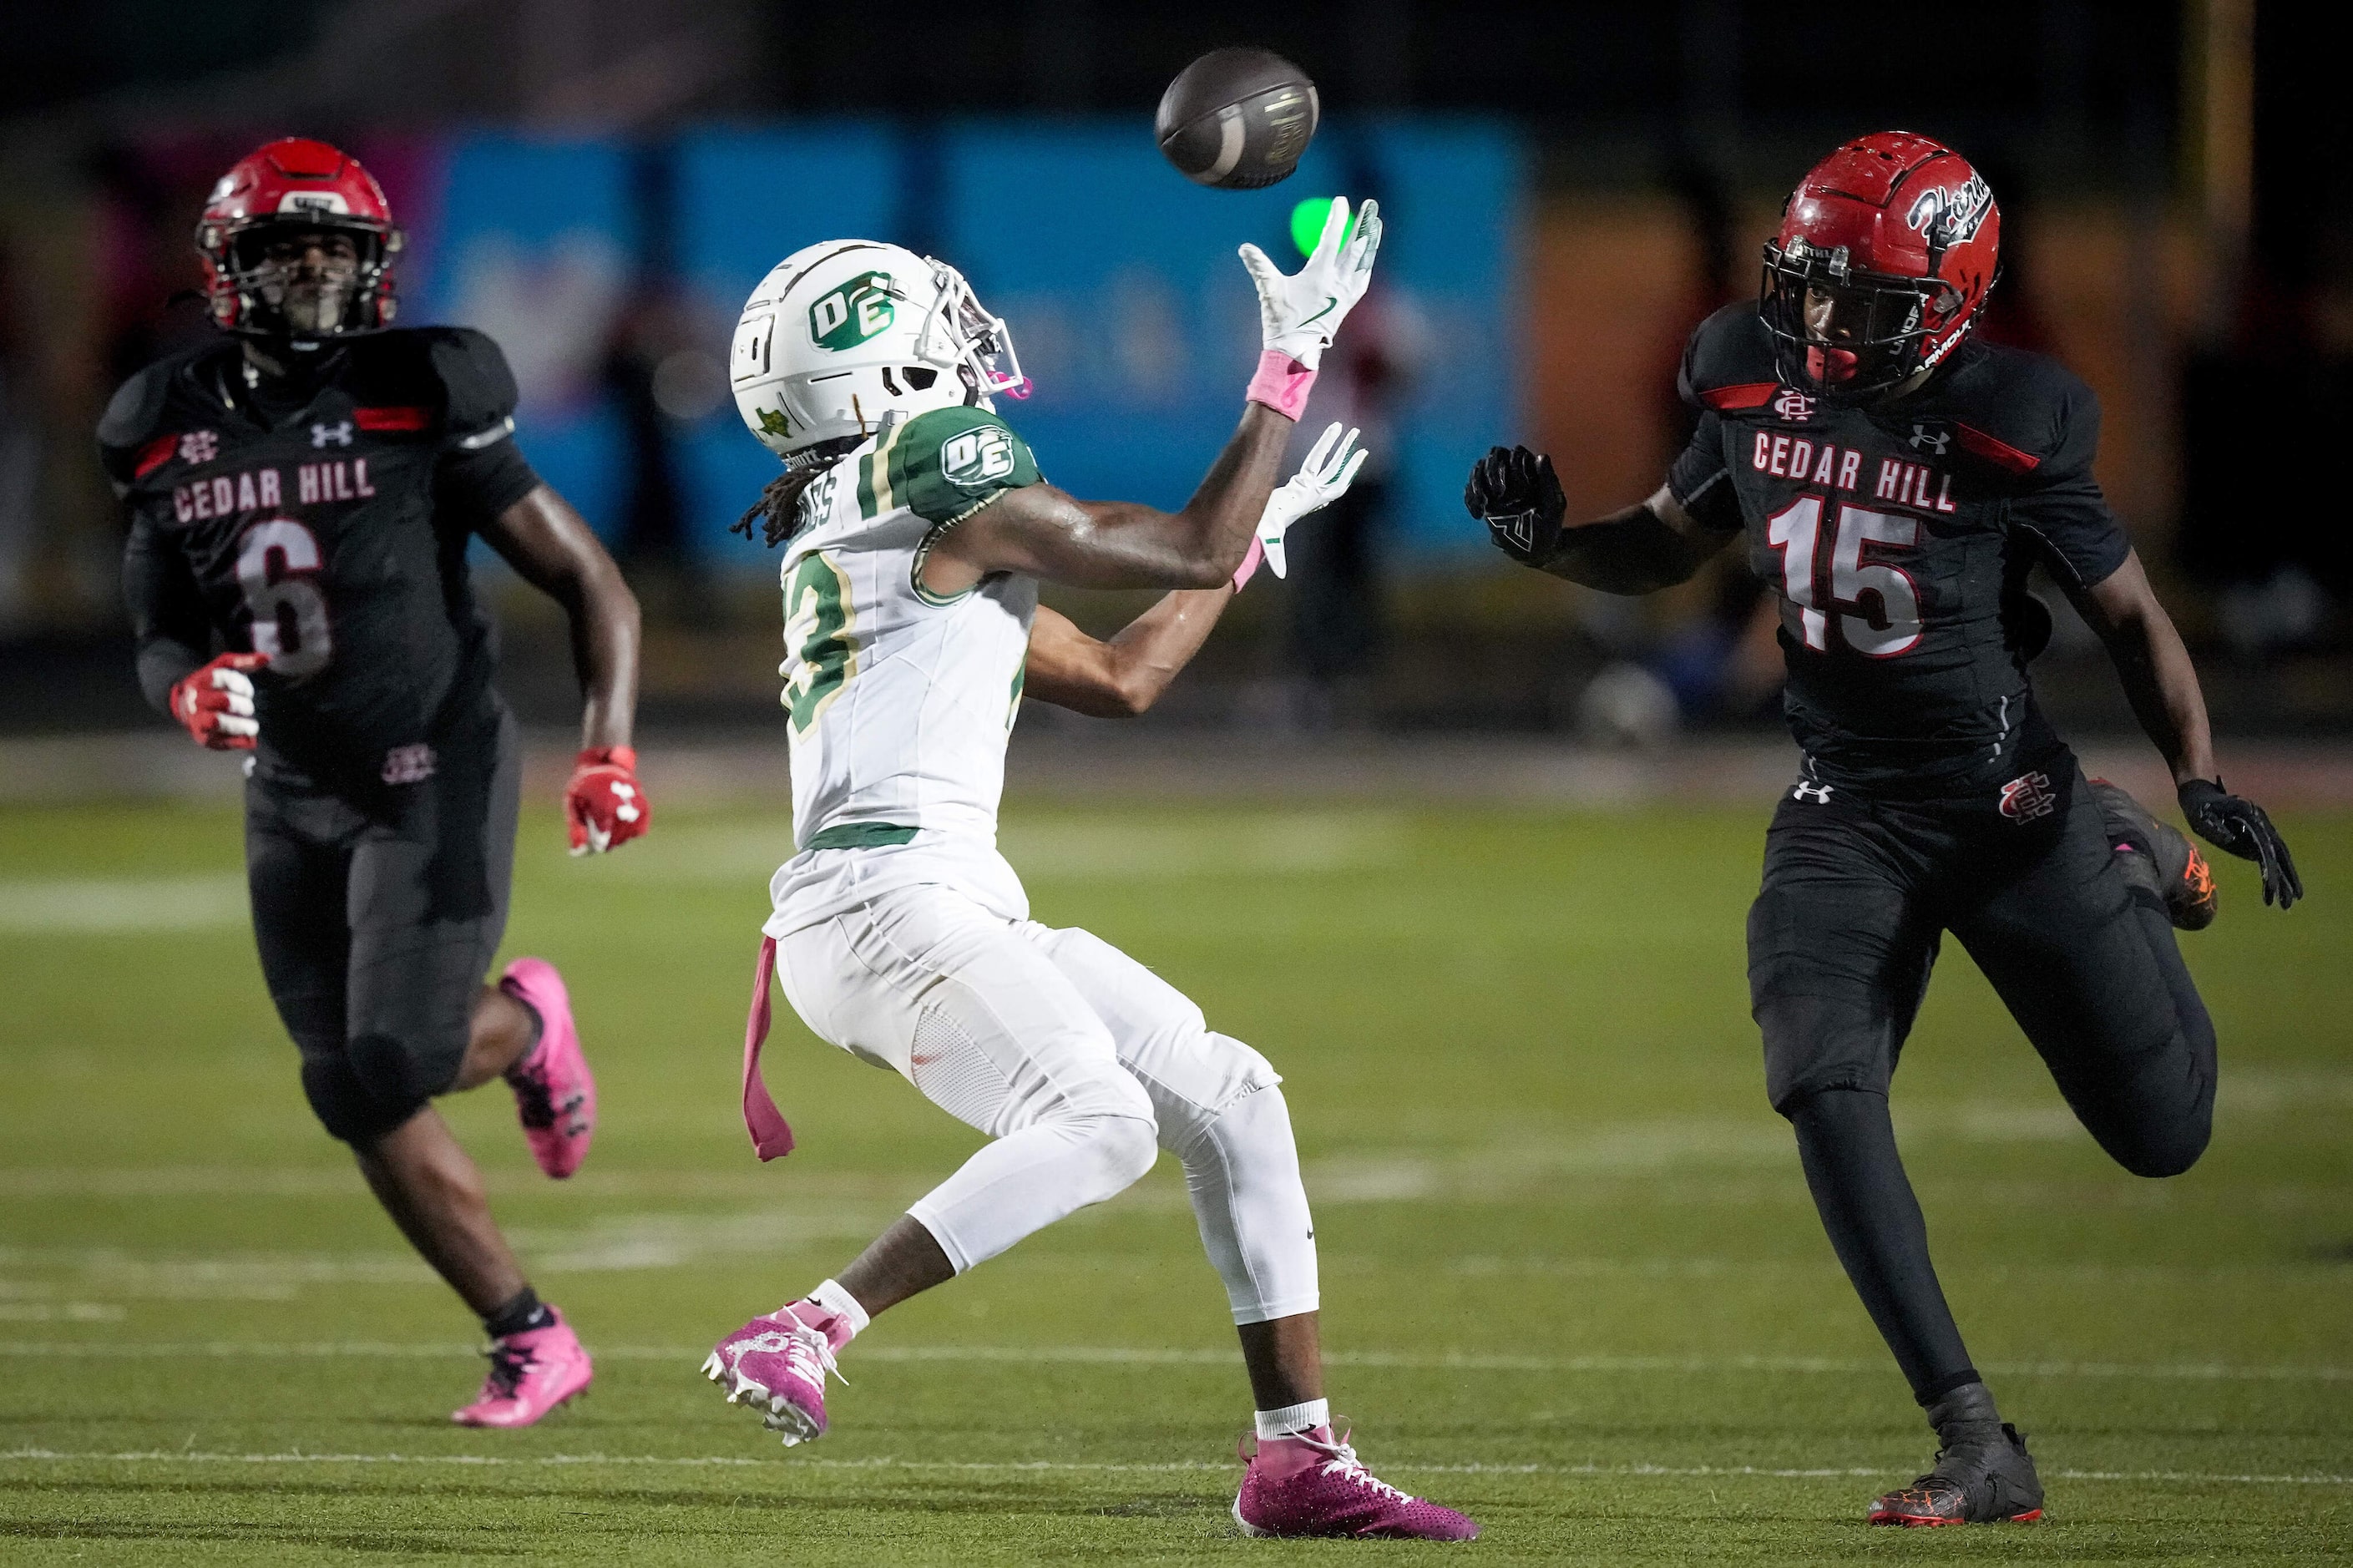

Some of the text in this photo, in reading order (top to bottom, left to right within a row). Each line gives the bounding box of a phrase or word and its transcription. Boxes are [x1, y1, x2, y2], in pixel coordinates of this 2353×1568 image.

[174, 458, 376, 524] CEDAR HILL
[946, 432, 1010, 477] DE
[1753, 429, 1958, 515] CEDAR HILL
[233, 514, 332, 676] 6
[1766, 492, 1925, 660] 15
